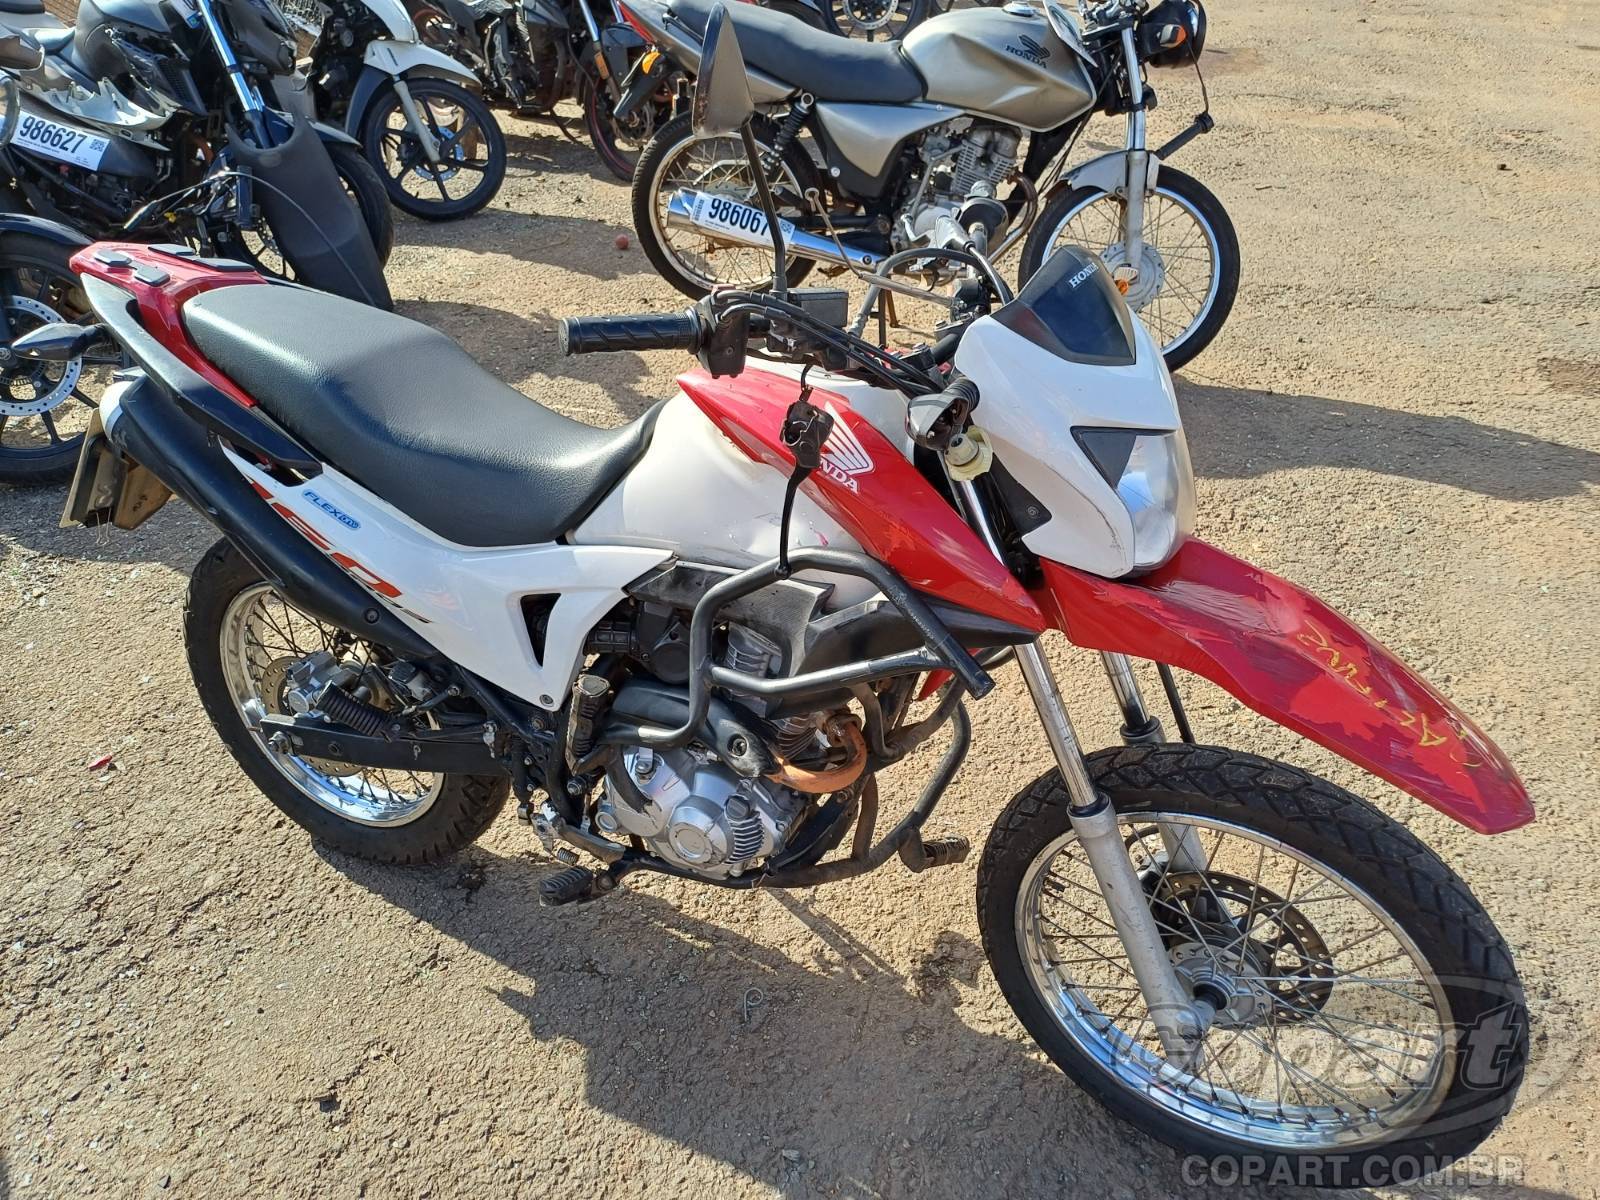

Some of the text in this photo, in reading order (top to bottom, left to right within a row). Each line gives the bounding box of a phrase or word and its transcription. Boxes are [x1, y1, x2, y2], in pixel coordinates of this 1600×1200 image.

[1005, 45, 1047, 69] HONDA
[20, 116, 88, 154] 986627
[817, 456, 860, 495] NDA
